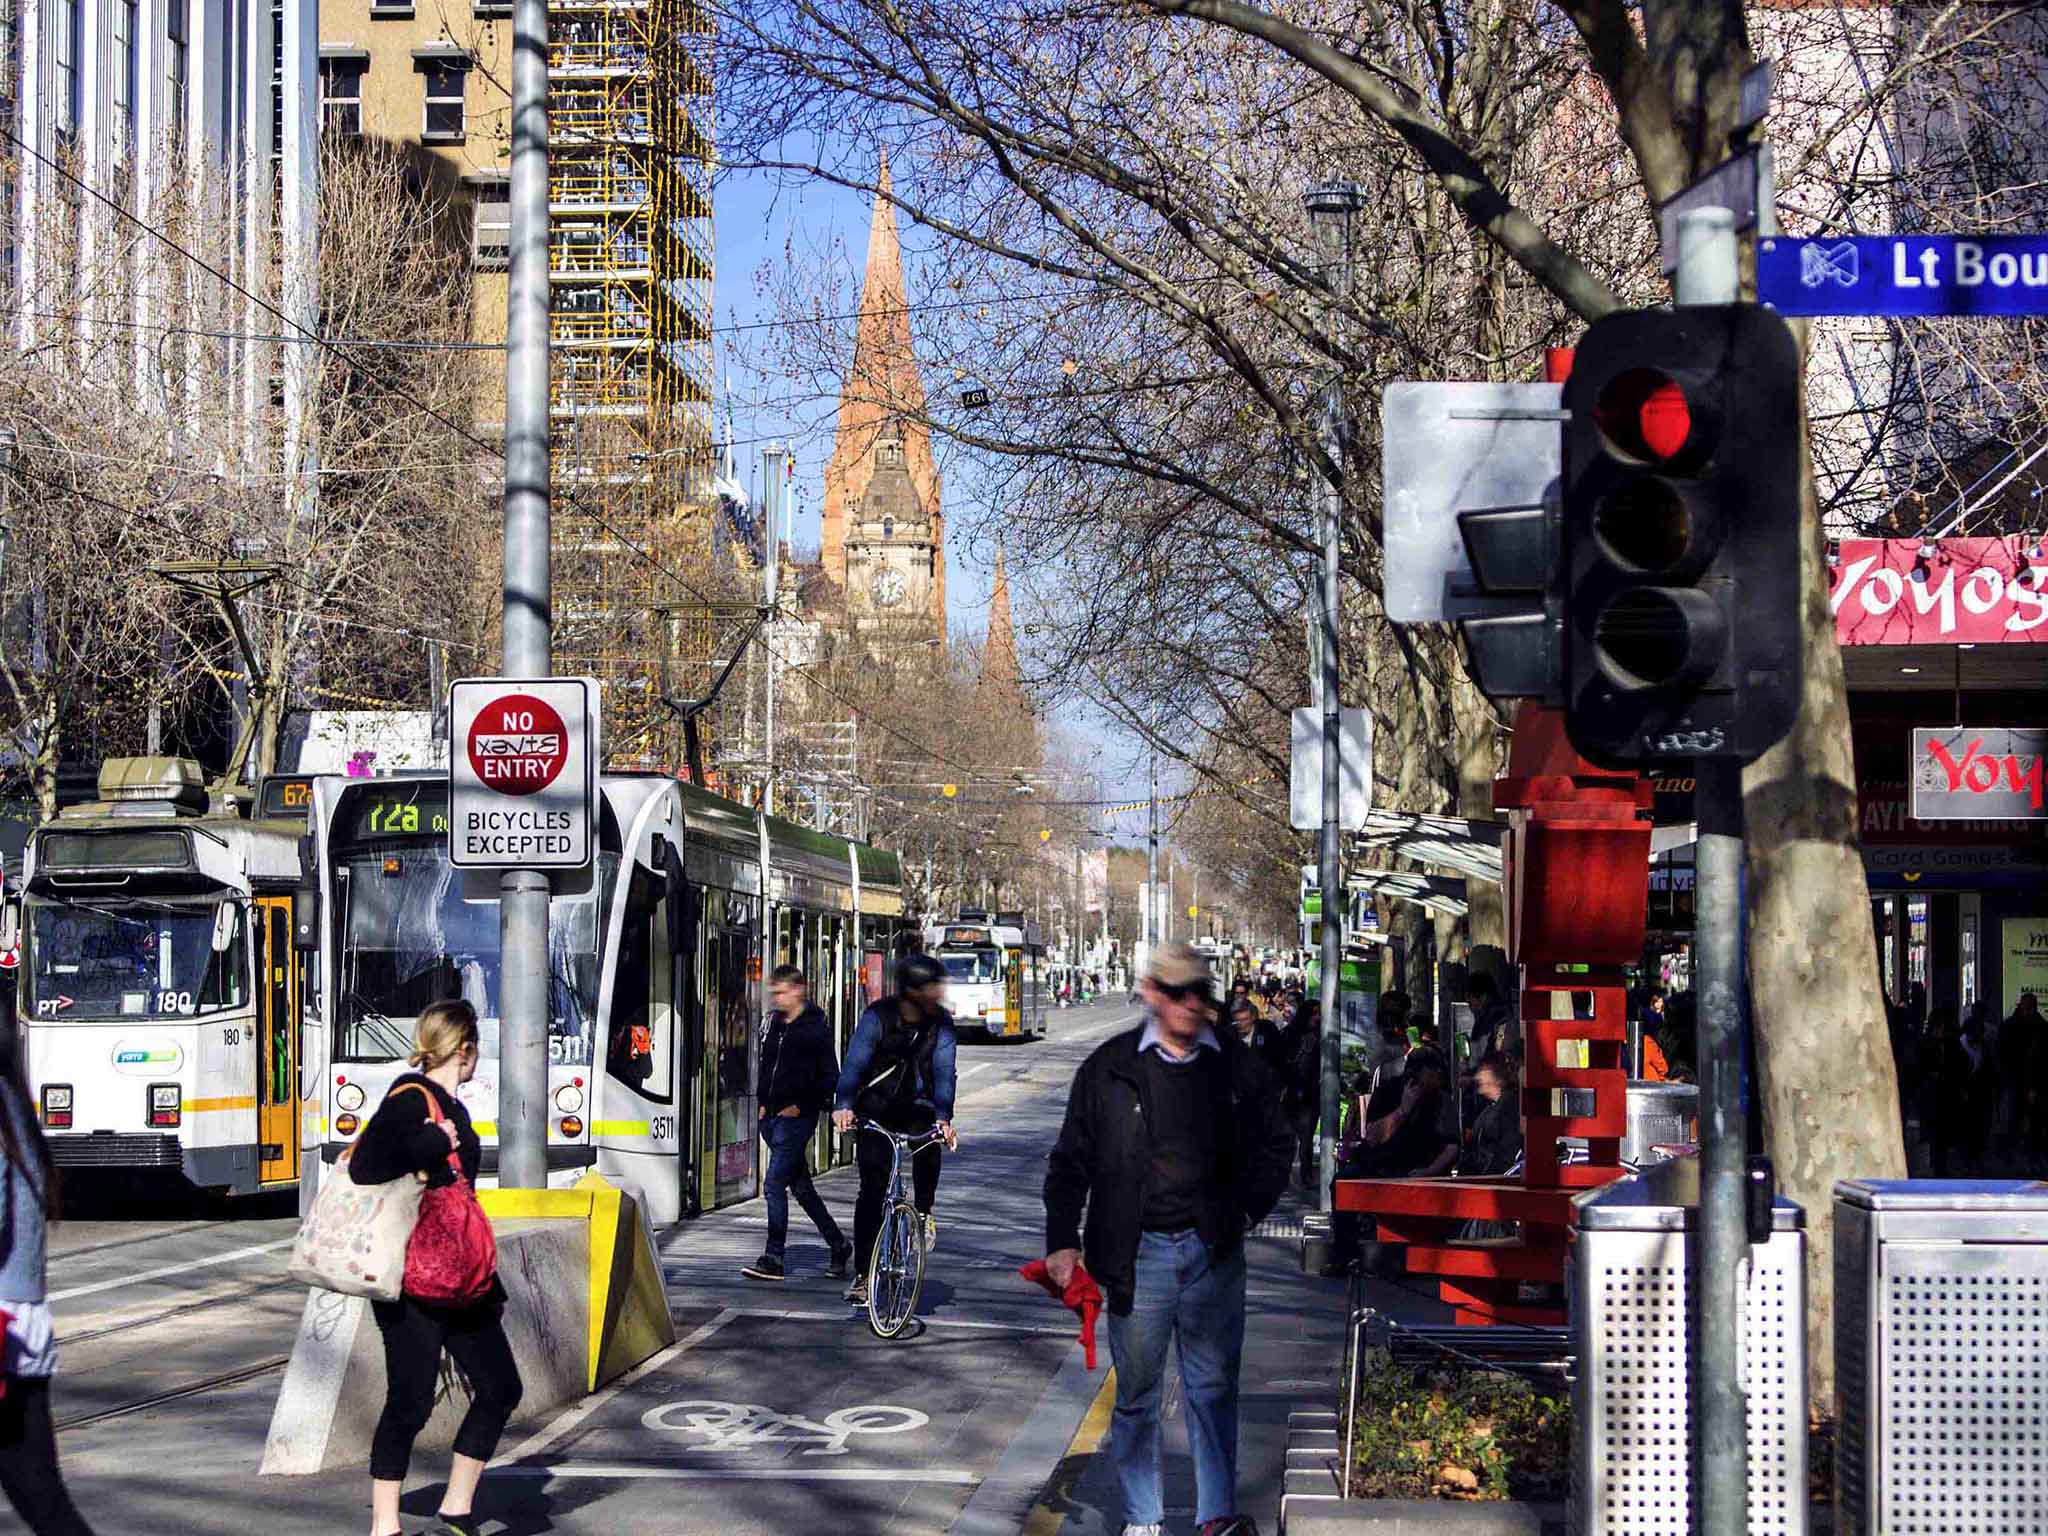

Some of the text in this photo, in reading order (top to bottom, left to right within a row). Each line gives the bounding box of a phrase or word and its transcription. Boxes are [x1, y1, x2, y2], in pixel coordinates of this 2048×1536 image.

[1894, 242, 2048, 287] Lt Bou
[503, 712, 533, 731] NO
[484, 759, 552, 778] ENTRY
[1925, 736, 2048, 810] Yoy
[468, 812, 571, 830] BICYCLES
[467, 836, 571, 854] EXCEPTED
[157, 991, 191, 1012] 180
[224, 1028, 239, 1045] 180
[653, 1116, 674, 1139] 3511
